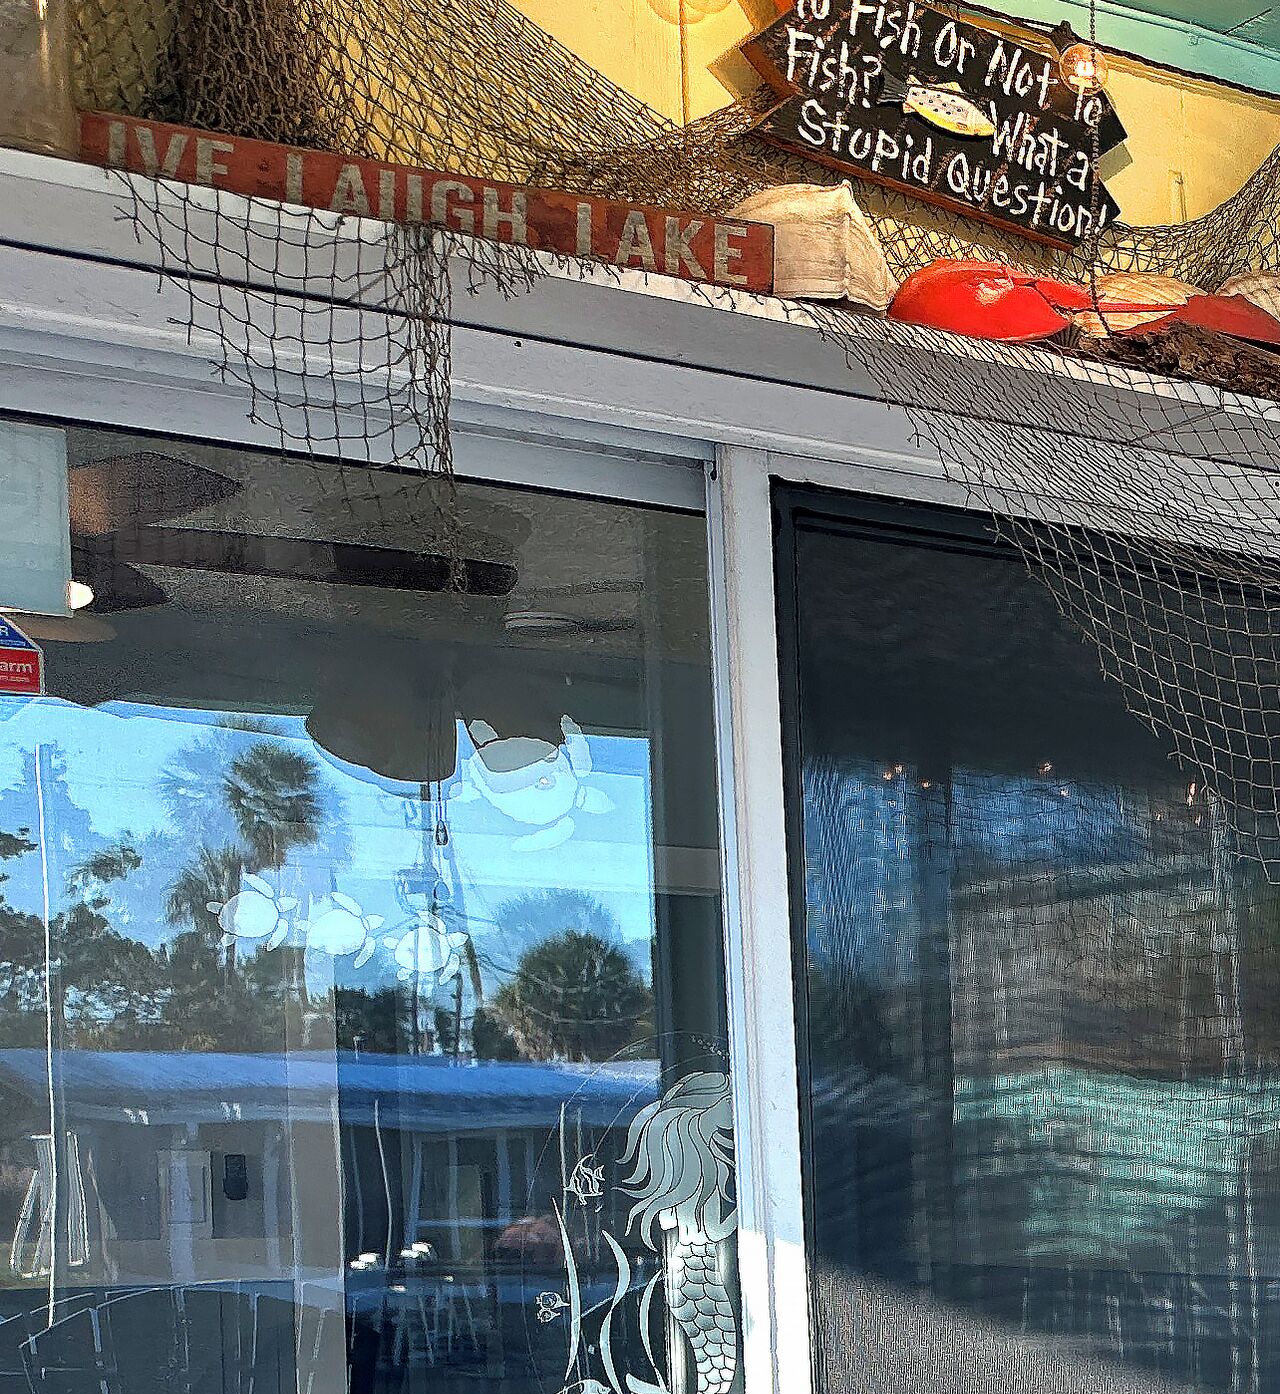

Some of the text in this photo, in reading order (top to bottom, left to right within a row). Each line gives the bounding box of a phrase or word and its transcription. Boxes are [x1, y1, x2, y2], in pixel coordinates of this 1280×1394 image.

[786, 27, 1089, 191] Fish? What a
[849, 0, 921, 57] Fish
[934, 21, 975, 73] Or
[985, 41, 1059, 106] Not
[108, 121, 748, 286] IVE LAUGH LAKE
[797, 99, 1109, 238] Stupid Question!
